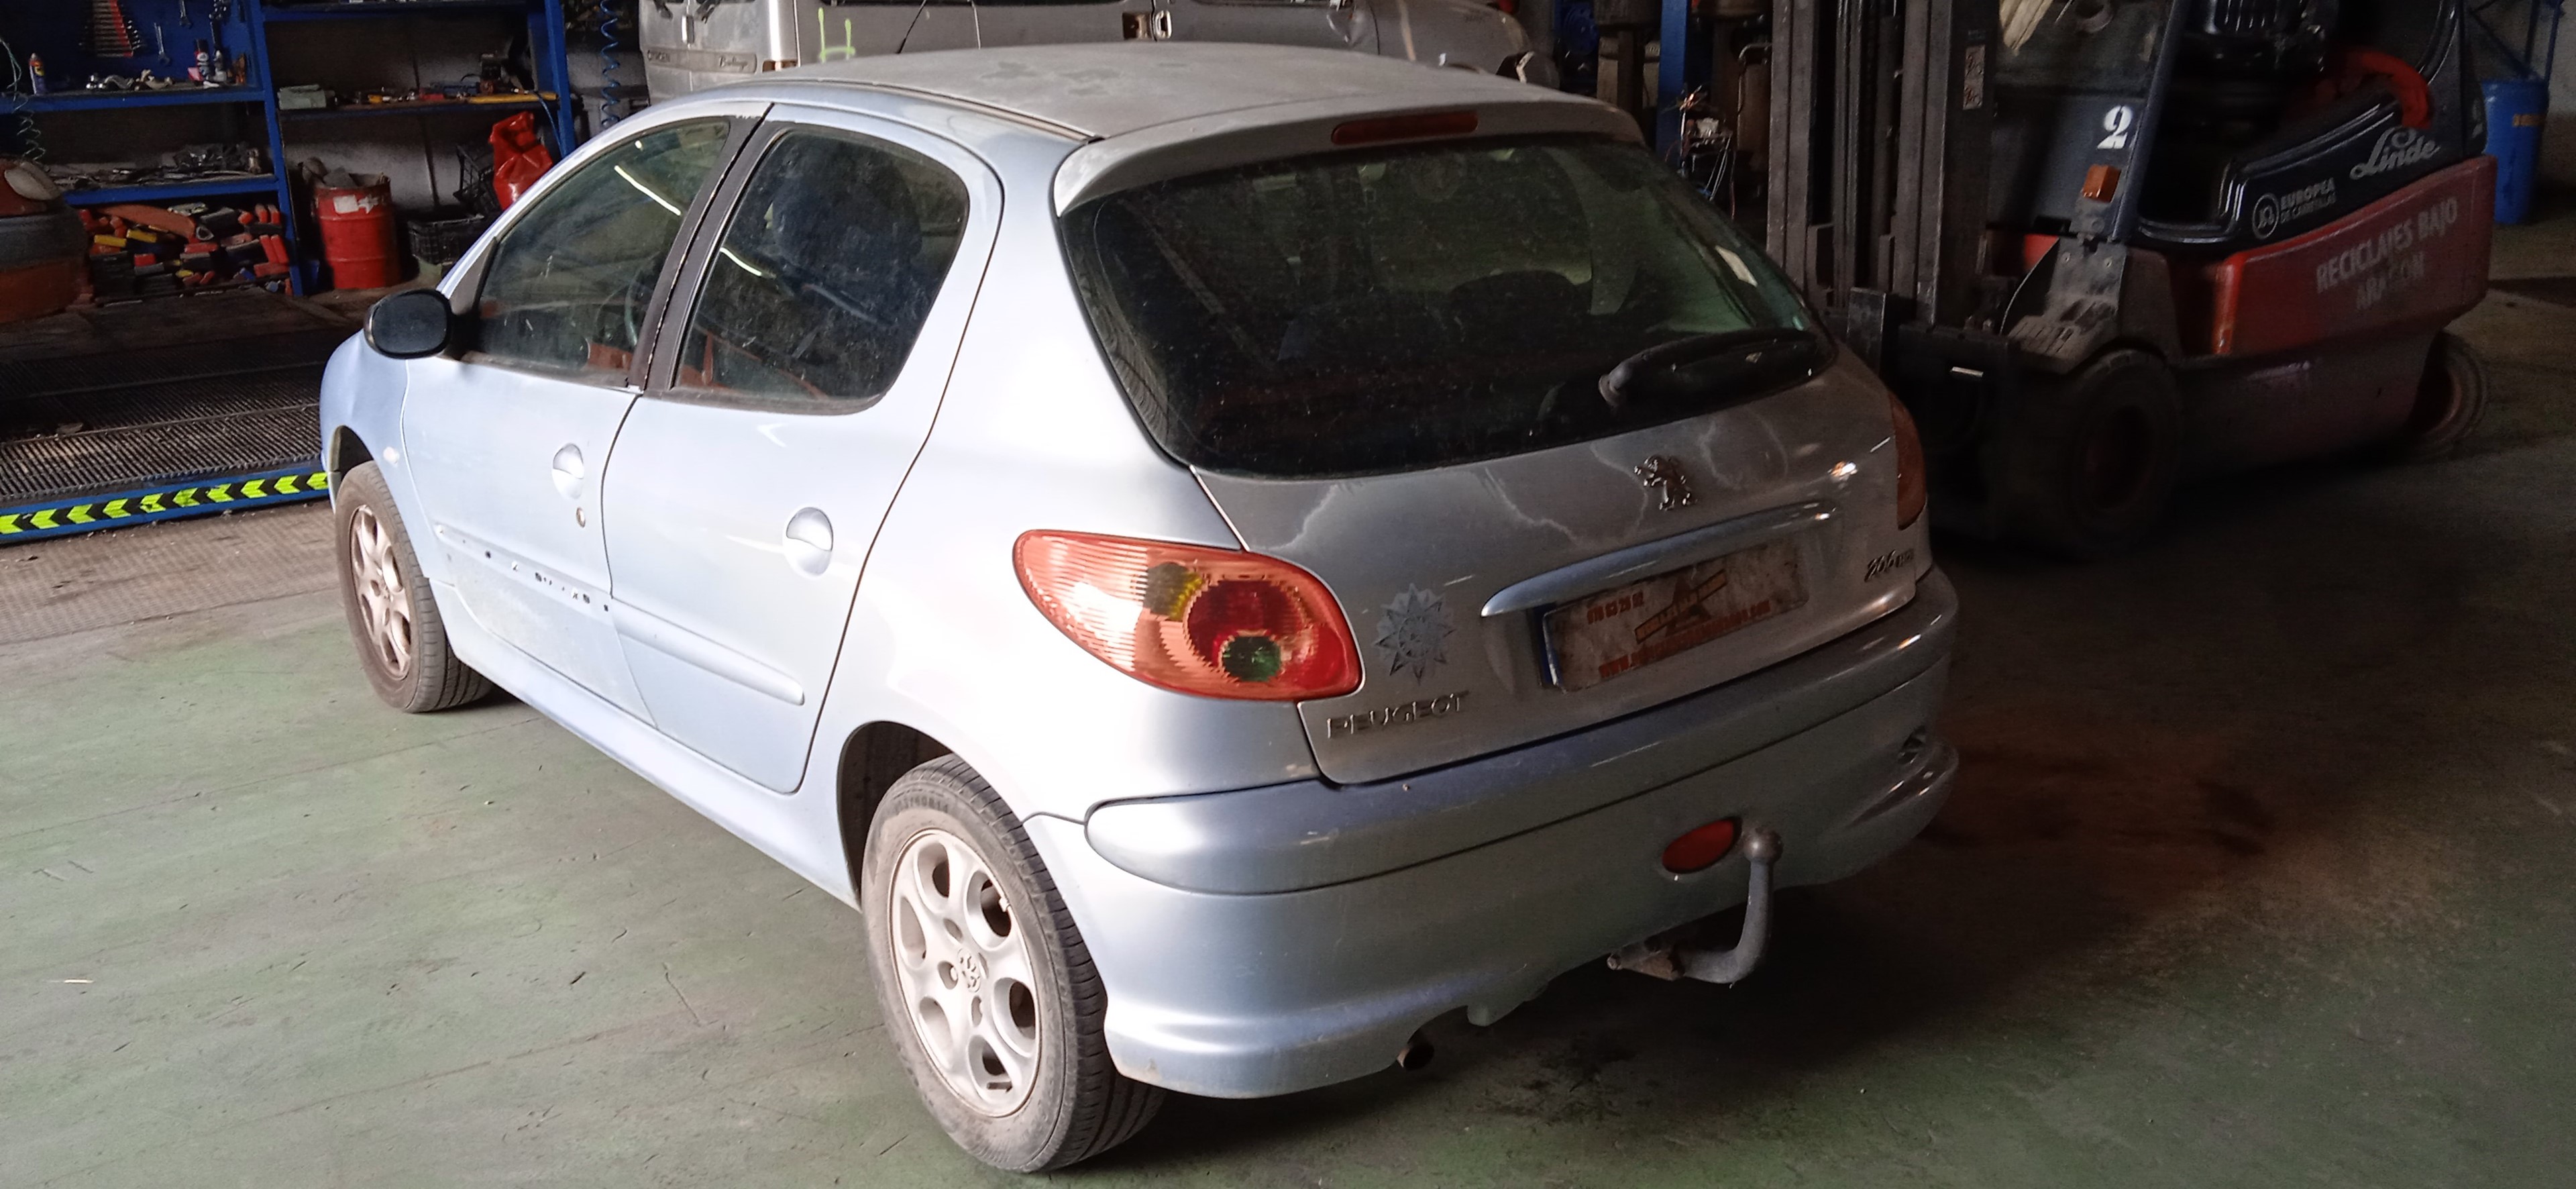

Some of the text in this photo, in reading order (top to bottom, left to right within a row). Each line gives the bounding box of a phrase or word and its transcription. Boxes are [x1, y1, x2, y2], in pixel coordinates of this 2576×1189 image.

[2096, 104, 2133, 150] 2
[2349, 125, 2442, 180] Linde
[2316, 197, 2458, 294] RECICLAJES BAJO
[1327, 691, 1470, 739] PEUGEOT
